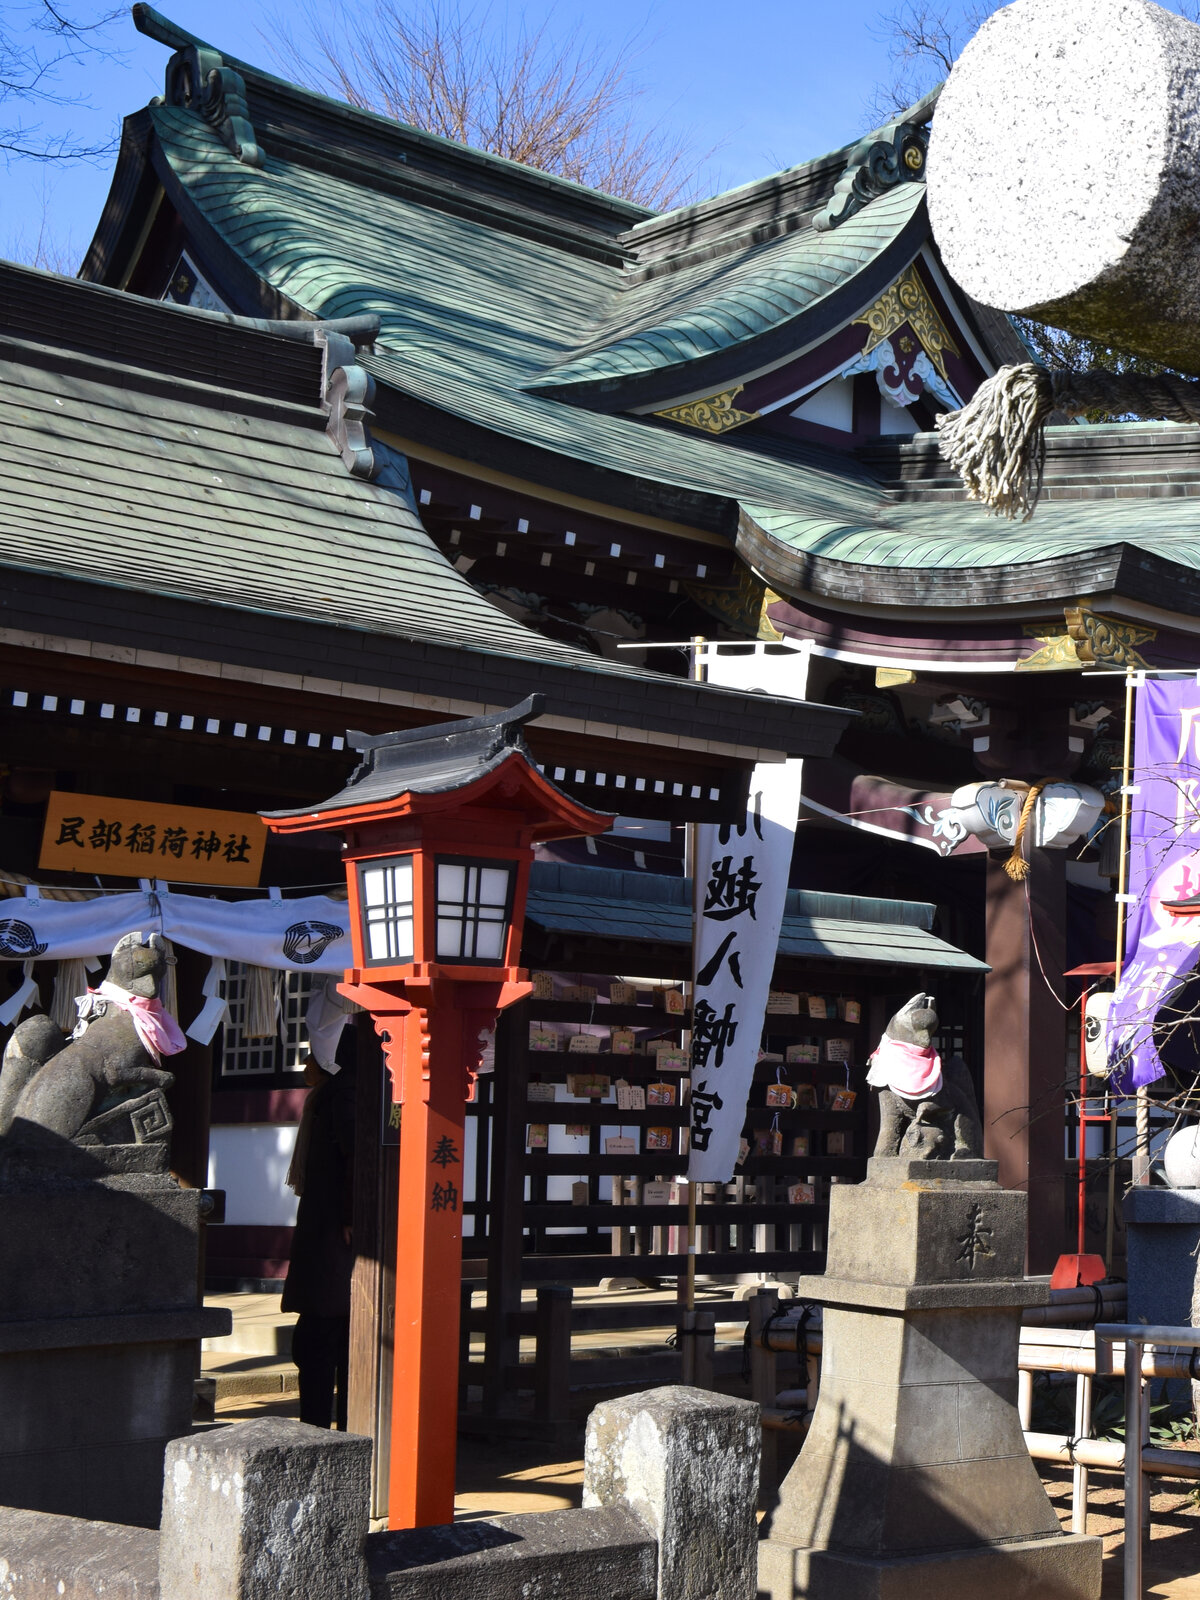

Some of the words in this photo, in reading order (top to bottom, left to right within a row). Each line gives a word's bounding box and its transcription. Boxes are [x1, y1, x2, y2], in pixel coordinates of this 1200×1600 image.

[55, 816, 252, 863] 民部稲荷神社
[430, 1135, 460, 1212] 奉納
